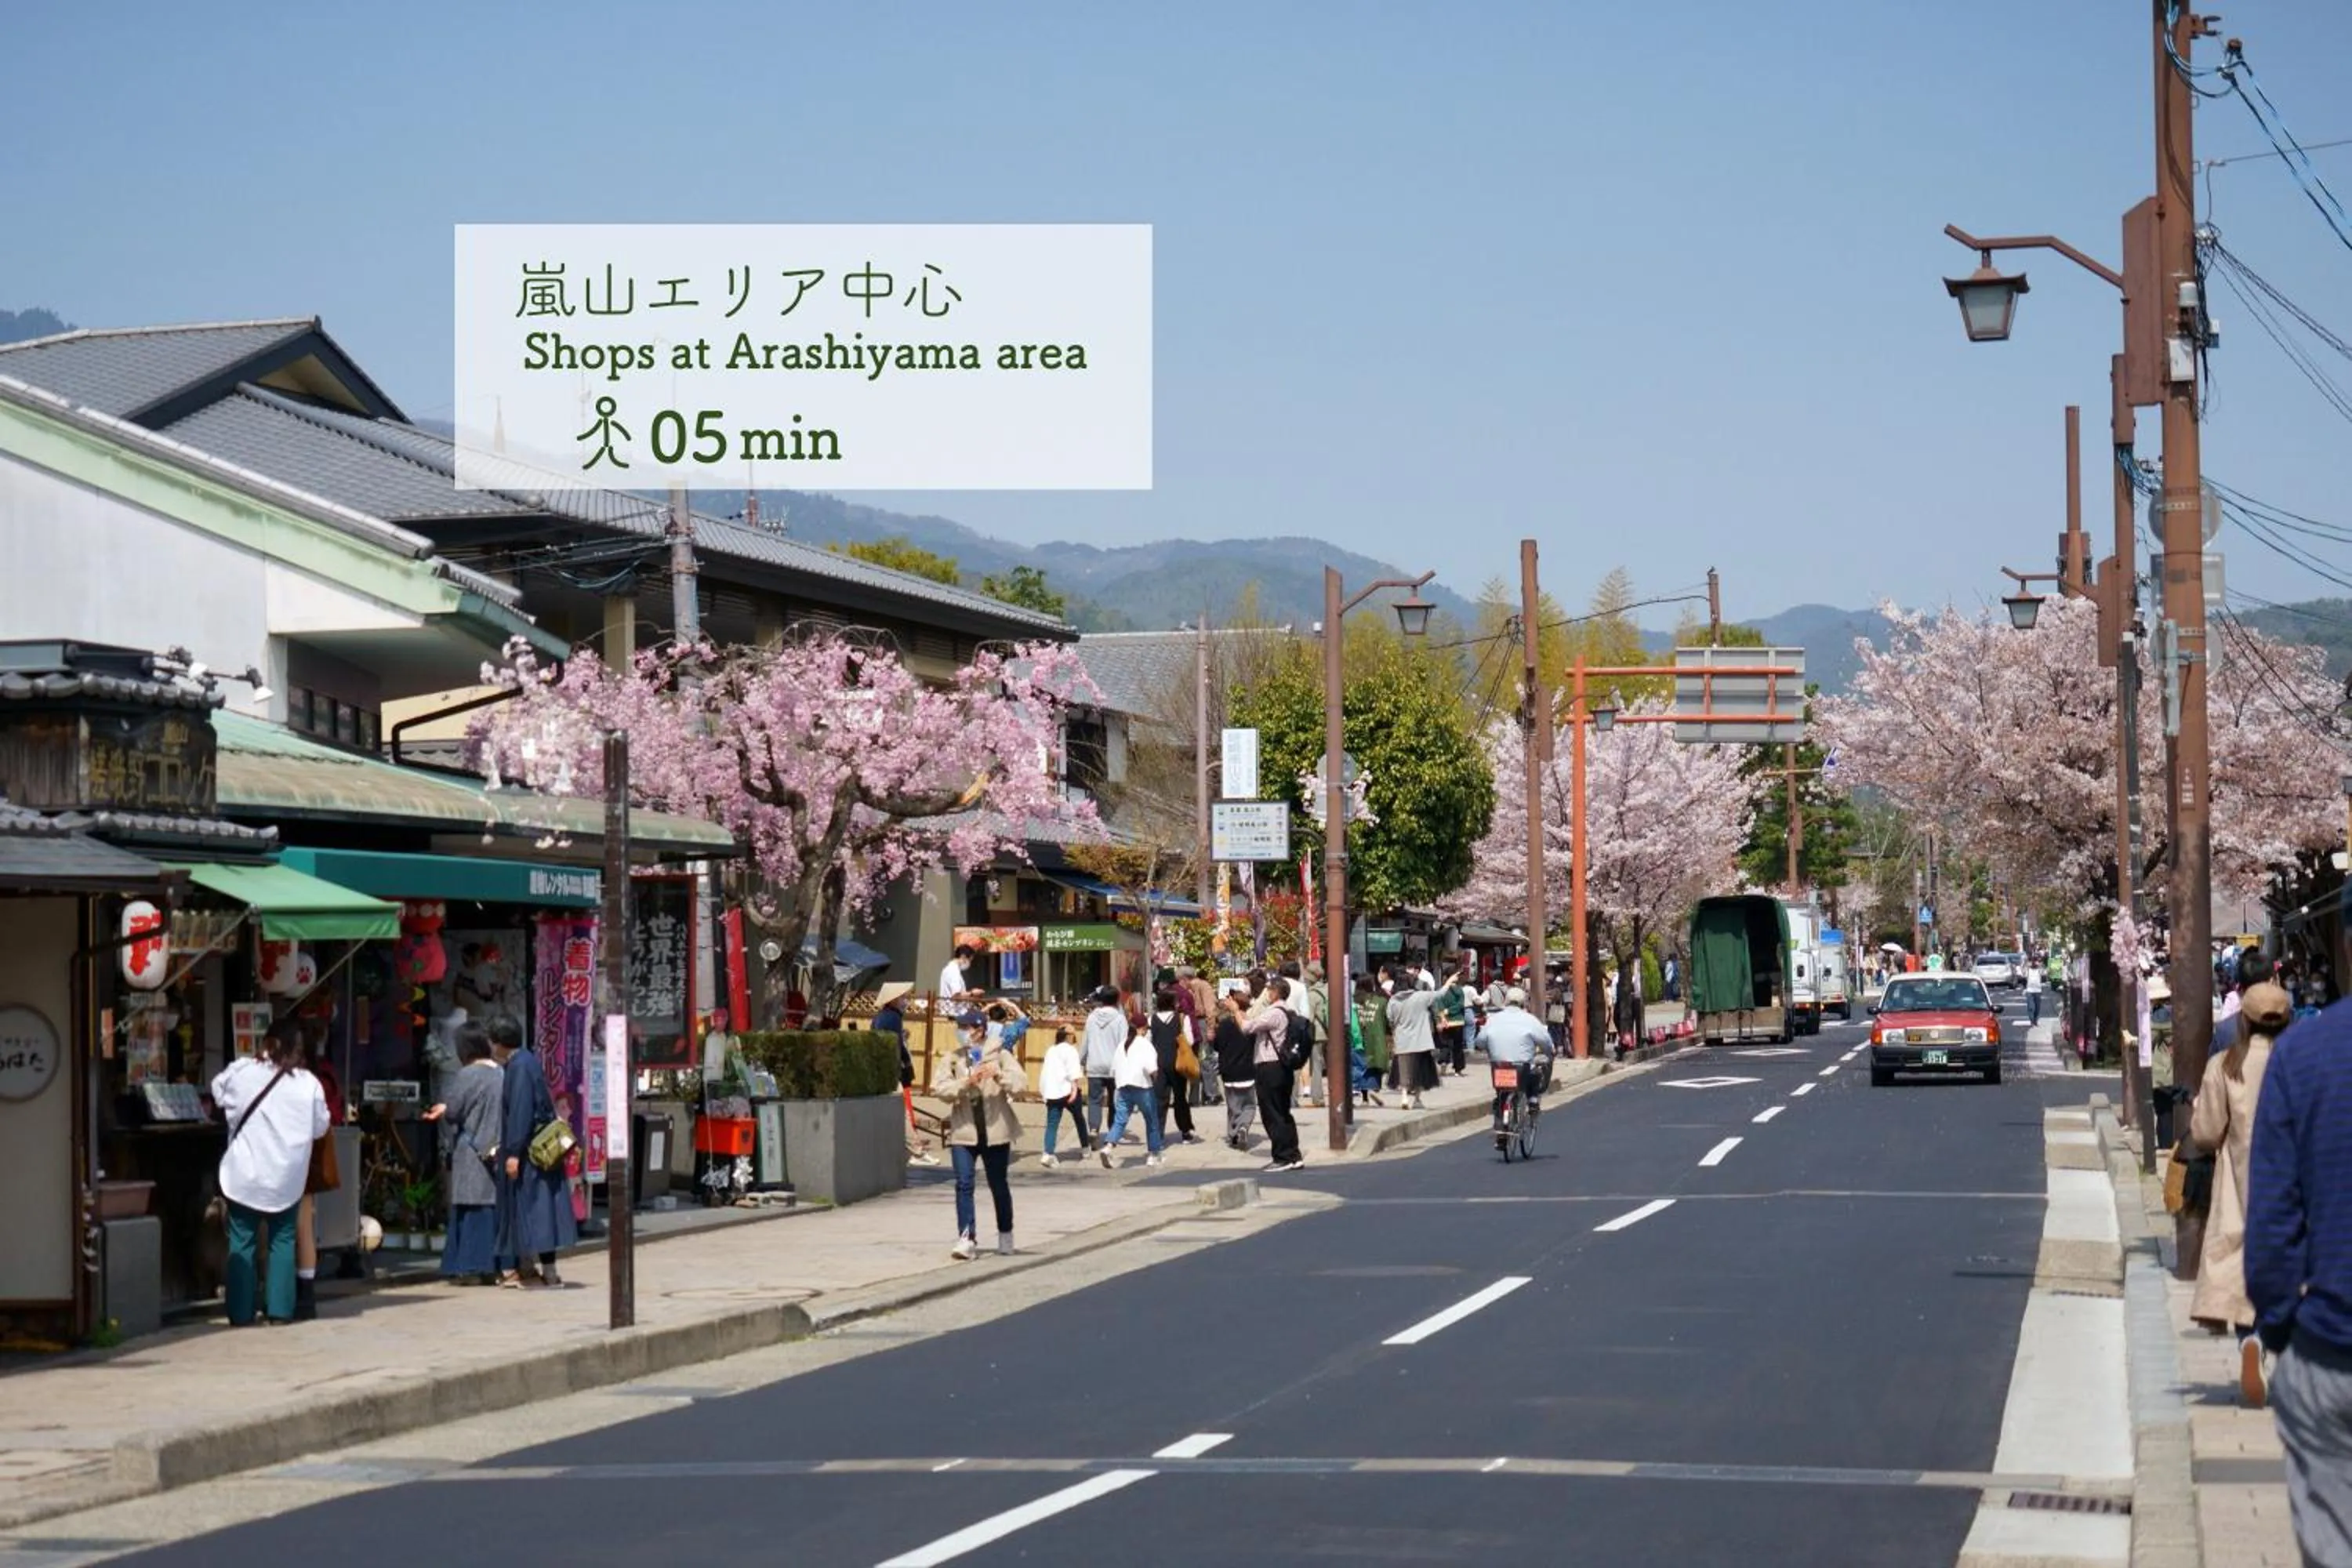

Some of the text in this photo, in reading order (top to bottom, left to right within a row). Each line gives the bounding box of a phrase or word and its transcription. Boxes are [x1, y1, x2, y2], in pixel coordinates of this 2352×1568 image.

[562, 938, 593, 1007] 着物
[630, 919, 648, 1017] とうがらし
[647, 912, 676, 1017] 世界最強
[539, 969, 564, 1087] レンタル
